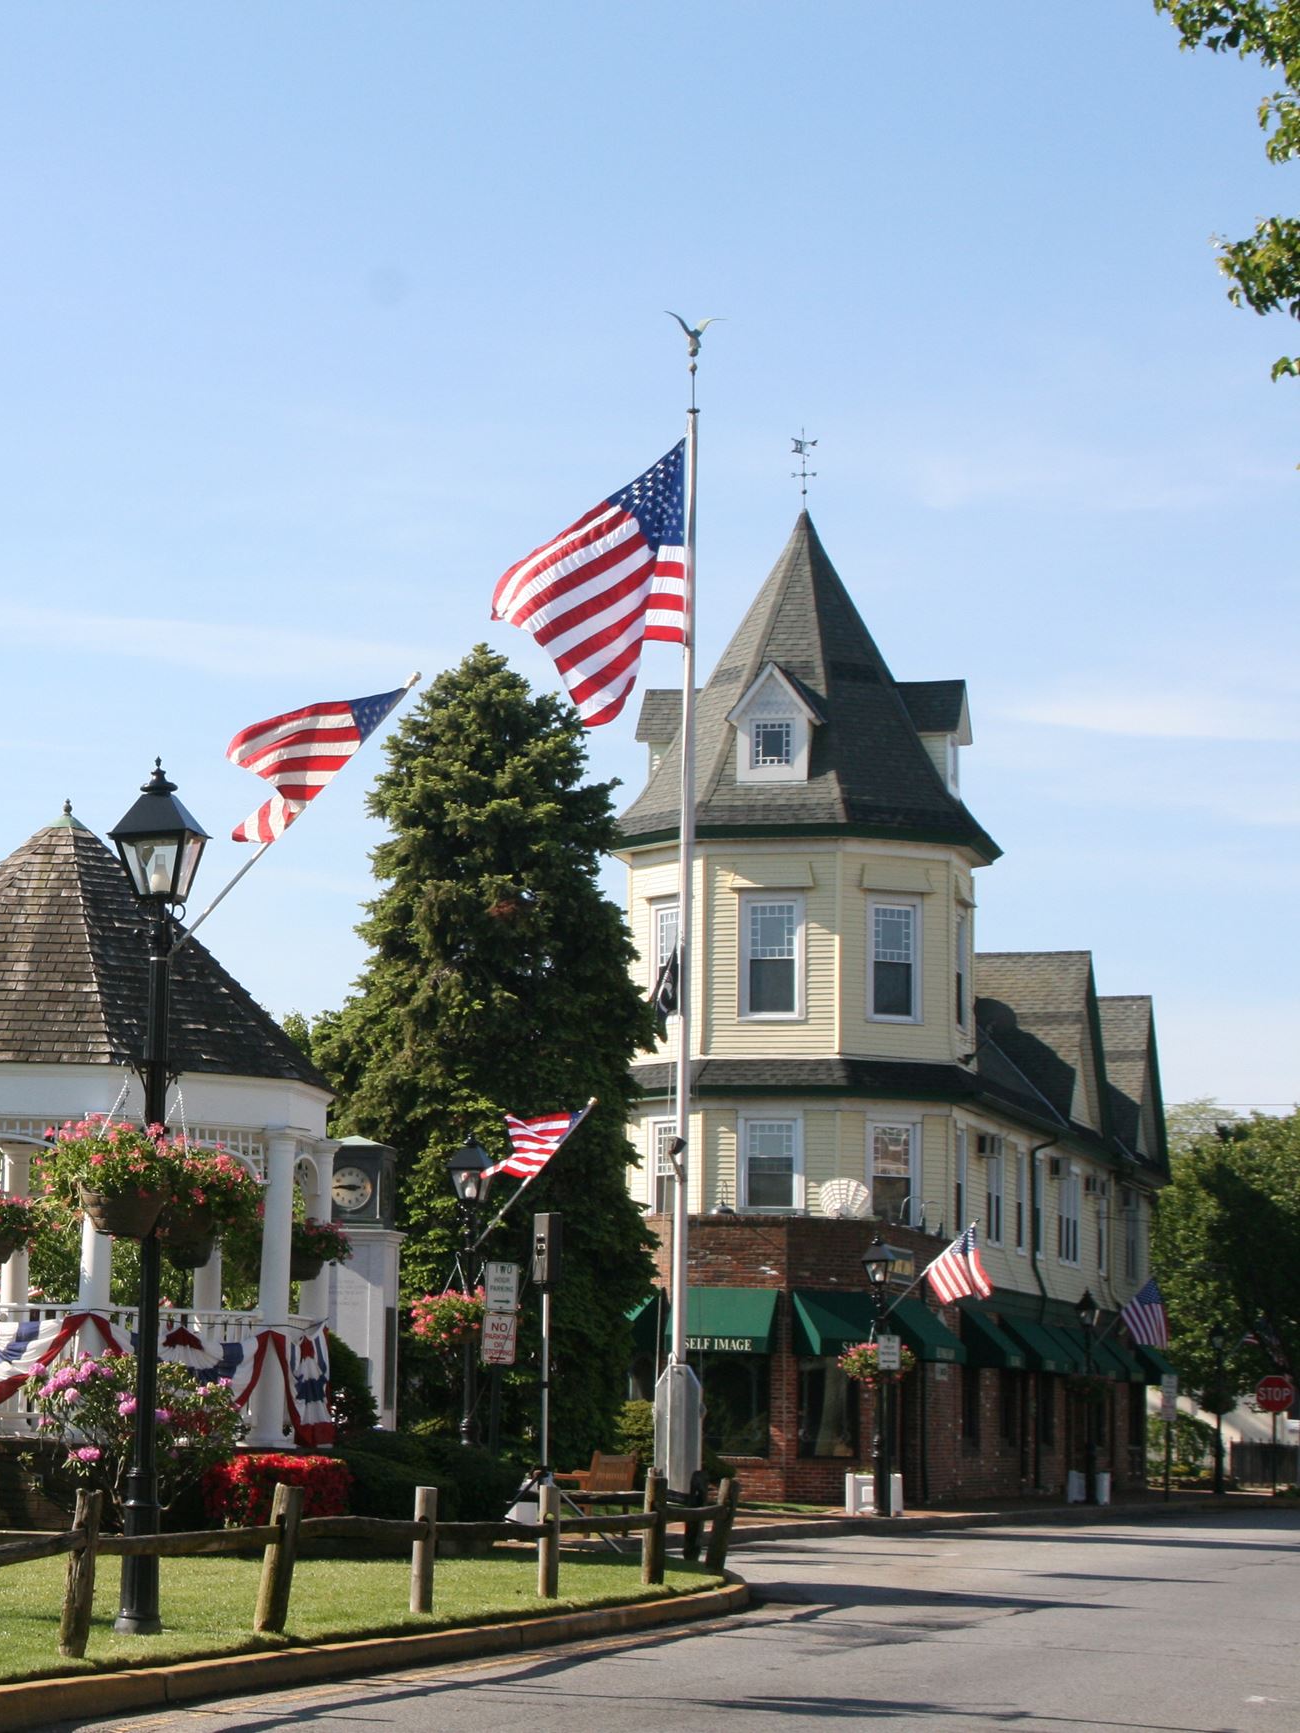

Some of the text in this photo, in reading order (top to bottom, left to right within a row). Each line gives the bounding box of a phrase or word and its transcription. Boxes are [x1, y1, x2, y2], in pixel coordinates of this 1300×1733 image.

[495, 1264, 513, 1274] TWO
[491, 1322, 508, 1332] NO
[484, 1333, 514, 1341] PARKING
[684, 1337, 752, 1351] SELF IMAGE
[1258, 1387, 1291, 1401] STOP
